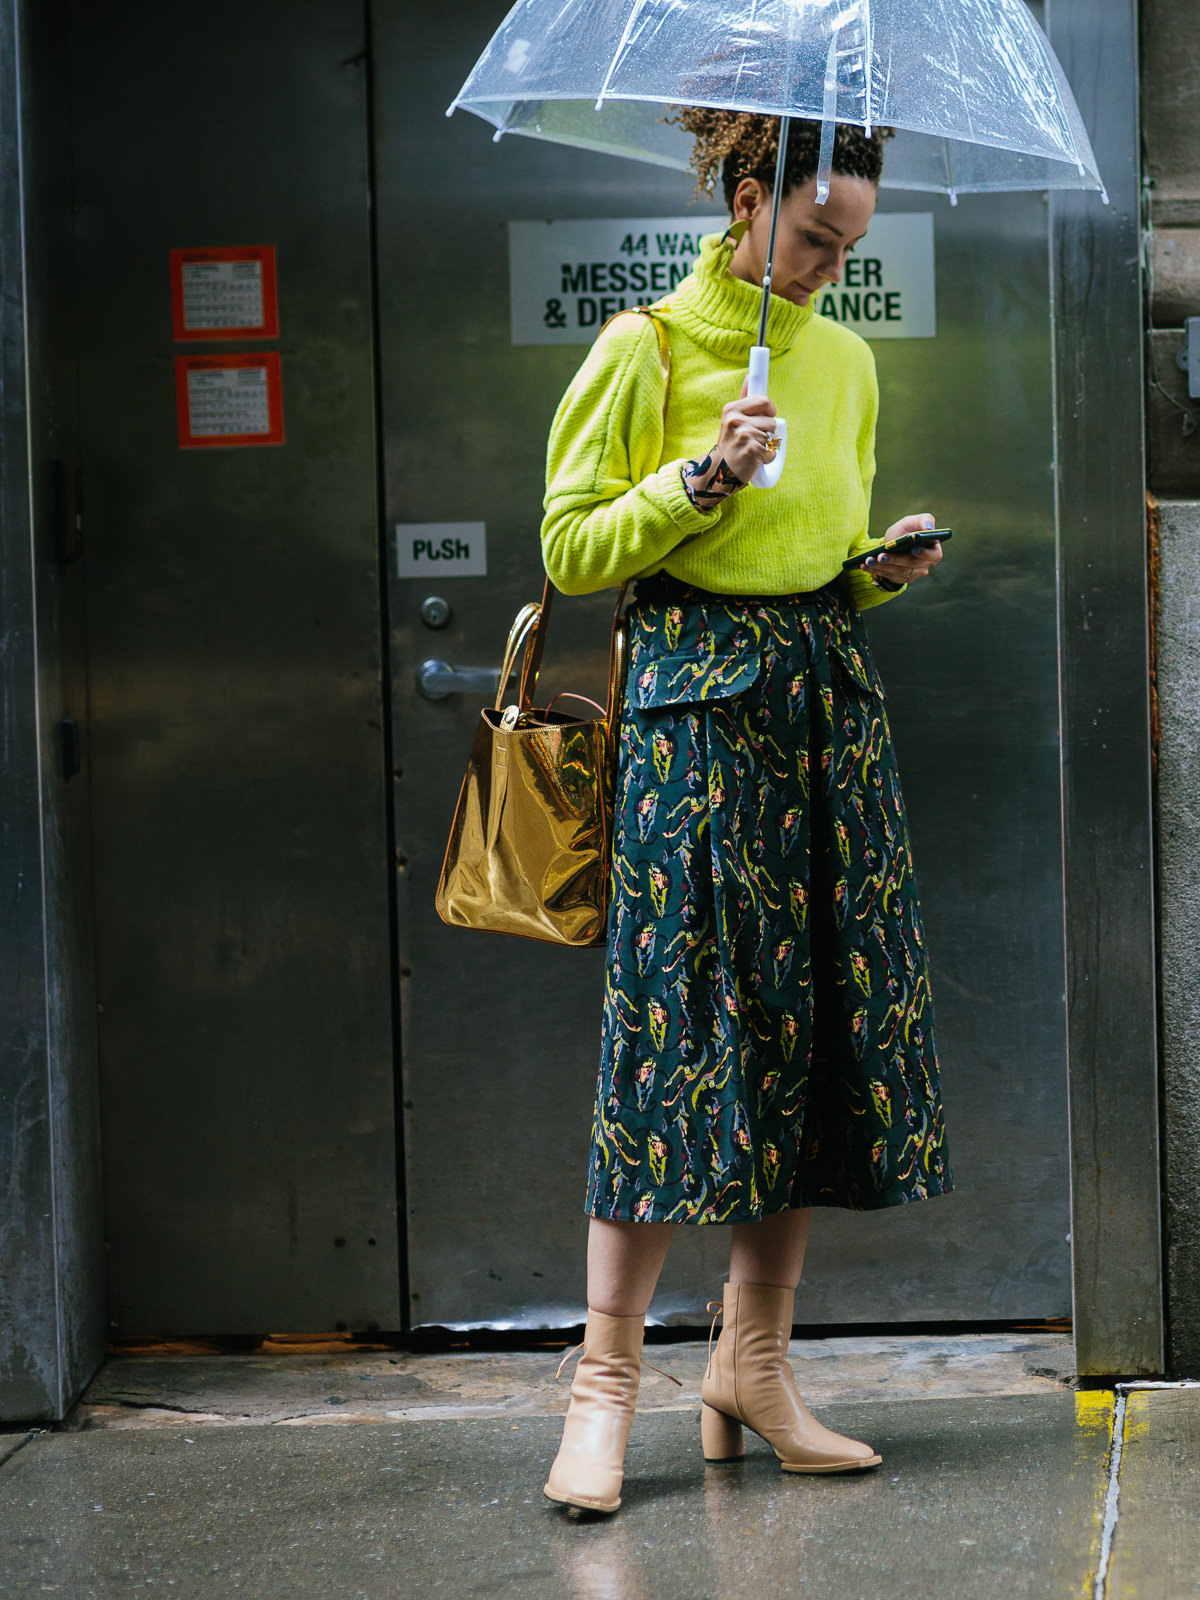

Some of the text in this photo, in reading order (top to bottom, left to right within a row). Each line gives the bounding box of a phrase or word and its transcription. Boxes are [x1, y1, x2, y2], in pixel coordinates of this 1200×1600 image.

[619, 233, 648, 256] 44
[561, 258, 883, 293] MESSEN ER
[543, 298, 567, 328] &
